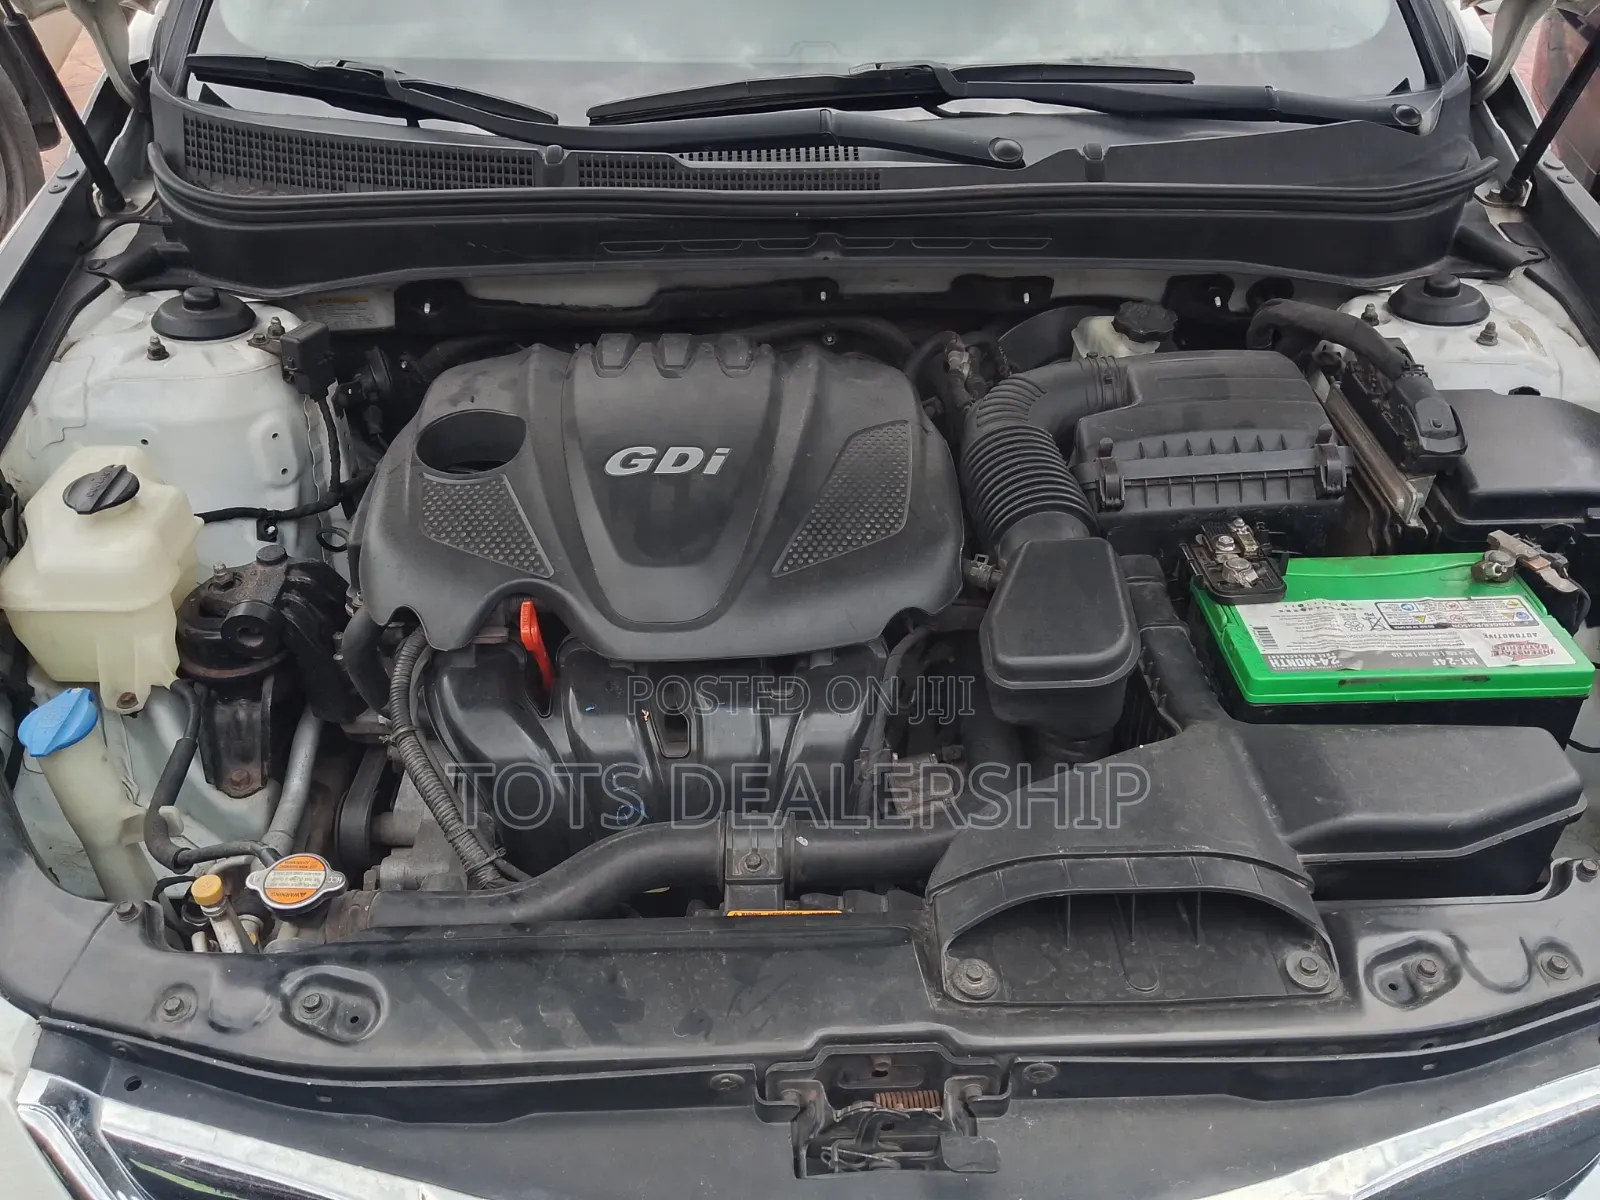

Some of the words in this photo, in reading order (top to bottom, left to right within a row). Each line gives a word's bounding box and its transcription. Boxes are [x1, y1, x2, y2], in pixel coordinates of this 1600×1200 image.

[604, 446, 731, 476] GDi
[1491, 643, 1549, 651] BATTERIES
[1491, 648, 1556, 657] INTERSTATE
[1268, 655, 1341, 669] 24-MONTH
[1432, 657, 1479, 667] MT-24F
